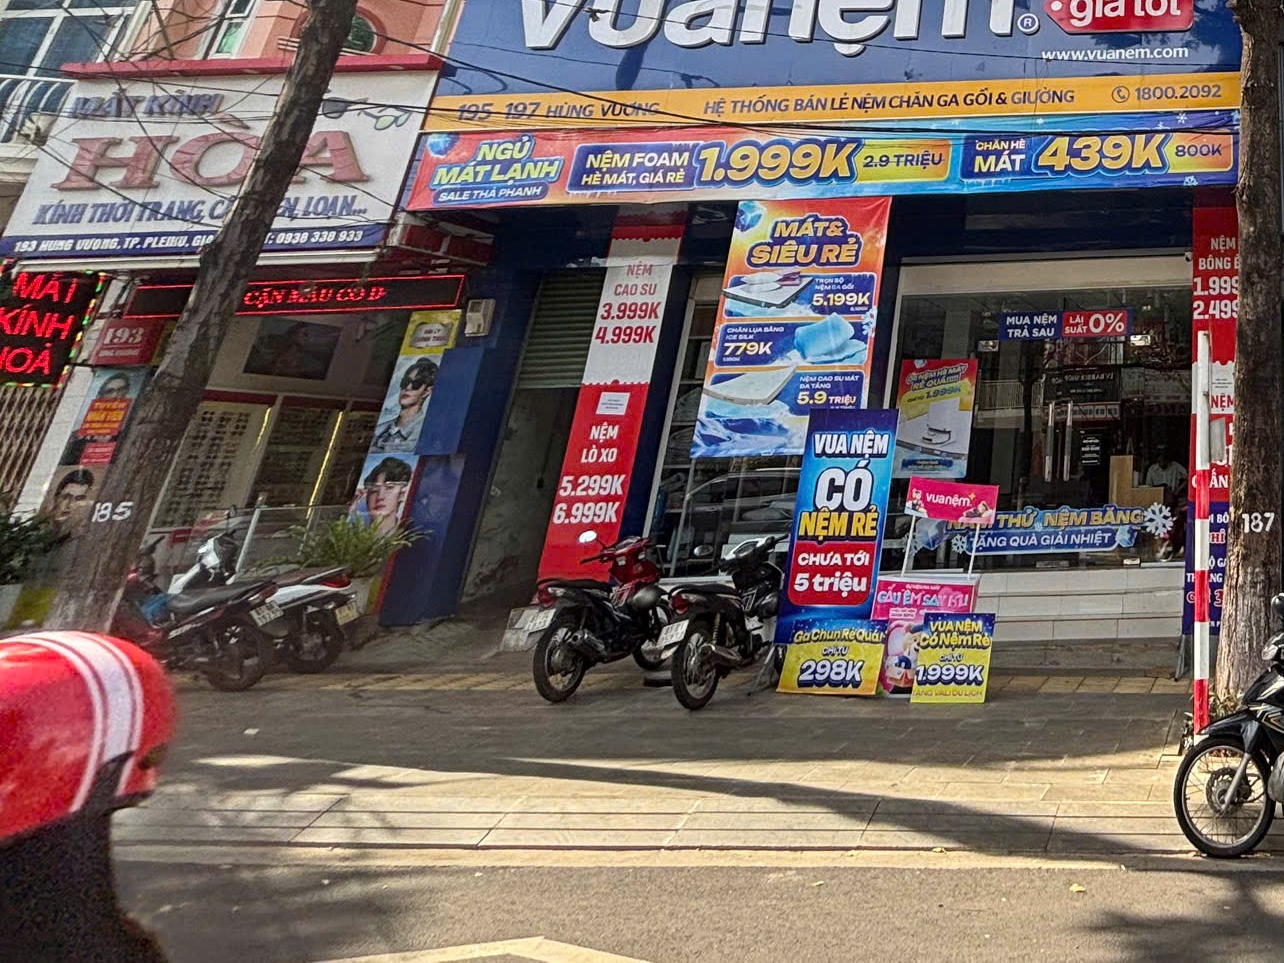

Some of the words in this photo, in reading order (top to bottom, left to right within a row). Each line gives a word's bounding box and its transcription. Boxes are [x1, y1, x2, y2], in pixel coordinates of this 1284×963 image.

[1041, 43, 1190, 63] www.vuanem.com
[143, 89, 225, 116] KÍNH
[703, 92, 726, 116] HỆ
[730, 92, 790, 114] THỐNG
[793, 91, 828, 113] BÁN
[830, 91, 851, 111] LẺ
[852, 92, 887, 114] NỆM
[888, 90, 935, 109] CHĂN
[937, 95, 960, 108] GA
[963, 86, 993, 107] GỐI
[996, 93, 1008, 105] &
[1011, 88, 1075, 106] GIƯỜNG
[1135, 84, 1222, 101] 1800.2092
[457, 102, 492, 121] 195
[504, 101, 541, 120] 197
[545, 99, 594, 119] HÙNG
[600, 99, 661, 118] VƯƠNG
[51, 112, 370, 191] HÒA
[476, 136, 532, 162] NGỦ
[973, 151, 1025, 173] MÁT
[1038, 133, 1167, 171] 439K
[1174, 142, 1223, 157] 800K
[975, 138, 1010, 151] CHĂN
[1011, 136, 1027, 149] HÈ
[585, 149, 631, 171] NỆM
[632, 151, 690, 168] FOAM
[698, 140, 856, 182] 1.999K
[863, 154, 890, 169] 2.9
[893, 149, 944, 170] TRIỆU
[433, 161, 484, 186] MÁT
[485, 159, 558, 185] LẠNH
[580, 169, 603, 186] HÈ
[603, 169, 637, 186] MÁT,
[638, 167, 665, 185] GIÁ
[666, 166, 685, 184] RẺ
[438, 189, 471, 203] SALE
[472, 185, 496, 200] THẢ
[498, 186, 543, 200] PHANH
[32, 199, 88, 225] KÍNH
[87, 197, 139, 224] THỜI
[773, 218, 846, 238] MÁT&
[14, 240, 37, 253] 193
[123, 236, 142, 249] TP.
[143, 234, 190, 248] PLEIKU,
[276, 232, 311, 245] 0938
[311, 231, 337, 243] 338
[337, 230, 364, 242] 933
[750, 239, 819, 265] SIÊU
[819, 236, 859, 264] RẺ
[1210, 234, 1236, 253] NỆM
[626, 260, 654, 279] NỆM
[1199, 254, 1232, 270] BÔNG
[614, 283, 639, 296] CAO
[639, 283, 658, 296] SU
[812, 292, 870, 306] 5.199K
[600, 301, 662, 320] 3.999K
[1005, 315, 1032, 326] MUA
[1033, 312, 1058, 326] NỆM
[1006, 325, 1031, 338] TRẢ
[1031, 327, 1055, 338] SAU
[1064, 323, 1089, 335] SUẤT
[1088, 312, 1126, 334] 0%
[103, 327, 145, 345] 193
[594, 325, 656, 345] 4.999K
[723, 341, 773, 356] 779K
[796, 390, 827, 405] 5.9
[828, 395, 857, 406] TRIỆU
[589, 421, 620, 443] NỆM
[813, 432, 848, 455] VUA
[850, 428, 889, 458] NỆM
[581, 444, 598, 463] LÒ
[597, 447, 618, 463] XO
[559, 474, 626, 497] 5.299K
[814, 458, 874, 511] CÓ
[926, 491, 971, 508] vuanệm
[91, 500, 134, 524] 185
[553, 501, 621, 525] 6.999K
[798, 507, 851, 542] NỆM
[852, 500, 879, 538] RẺ
[996, 504, 1037, 528] THỬ
[1043, 505, 1087, 529] NỆM
[1089, 501, 1144, 525] BĂNG
[1241, 512, 1275, 534] 187
[1005, 529, 1038, 548] QUÀ
[1041, 528, 1072, 548] GIẢI
[1074, 527, 1112, 548] NHIỆT
[797, 551, 835, 567] CHƯA
[837, 547, 870, 567] TỚI
[793, 572, 809, 592] 5
[811, 572, 868, 598] triệu
[929, 620, 954, 632] VUA
[953, 617, 984, 634] NỆM
[793, 629, 812, 644] Ga
[811, 628, 842, 644] Chun
[919, 632, 939, 647] Có
[940, 631, 972, 651] Nệm
[970, 631, 991, 648] Rẻ
[798, 660, 864, 684] 298K
[915, 663, 984, 683] 1.999K
